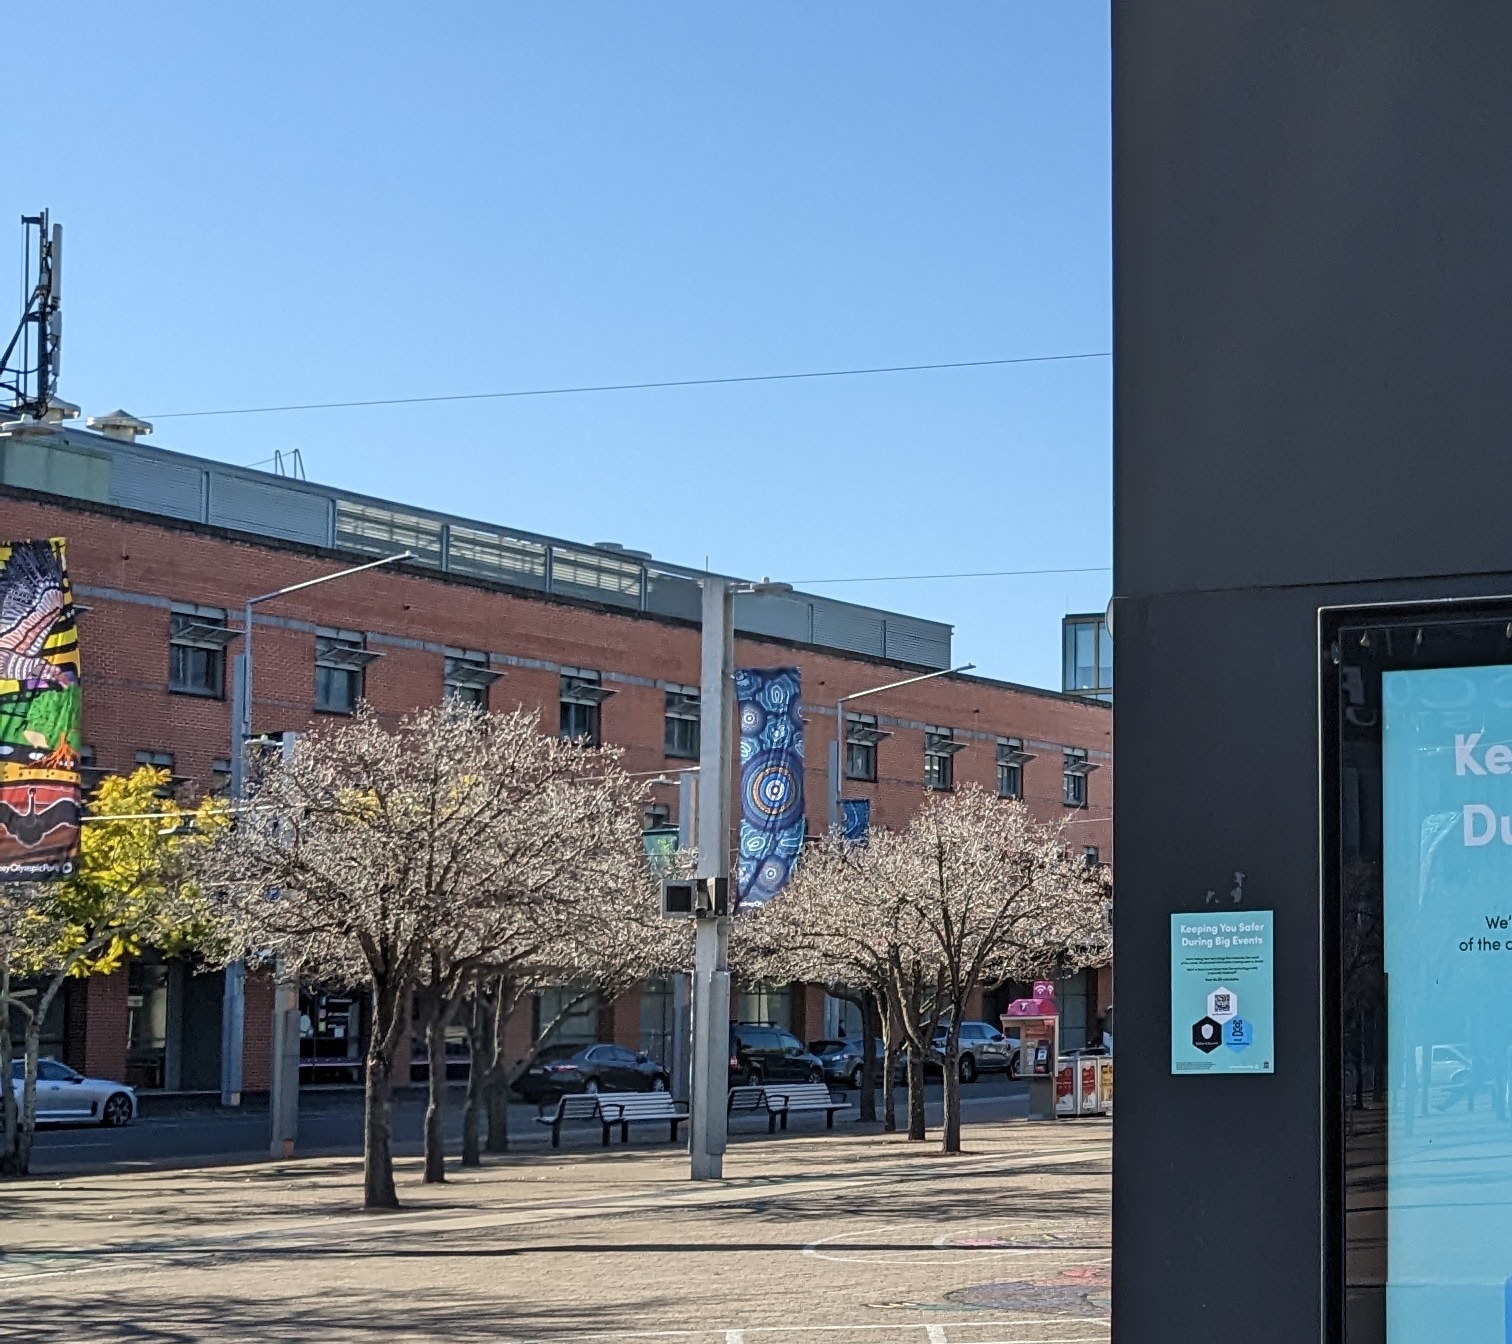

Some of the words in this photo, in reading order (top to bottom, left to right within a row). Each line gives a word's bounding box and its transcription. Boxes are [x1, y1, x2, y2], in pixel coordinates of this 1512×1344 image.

[1180, 924, 1218, 935] Keeping
[1219, 923, 1237, 932] You
[1239, 922, 1264, 932] Safer
[1182, 937, 1213, 948] During
[1215, 936, 1230, 948] Big
[1232, 936, 1263, 945] Events
[1459, 937, 1474, 951] of
[1477, 937, 1501, 951] the
